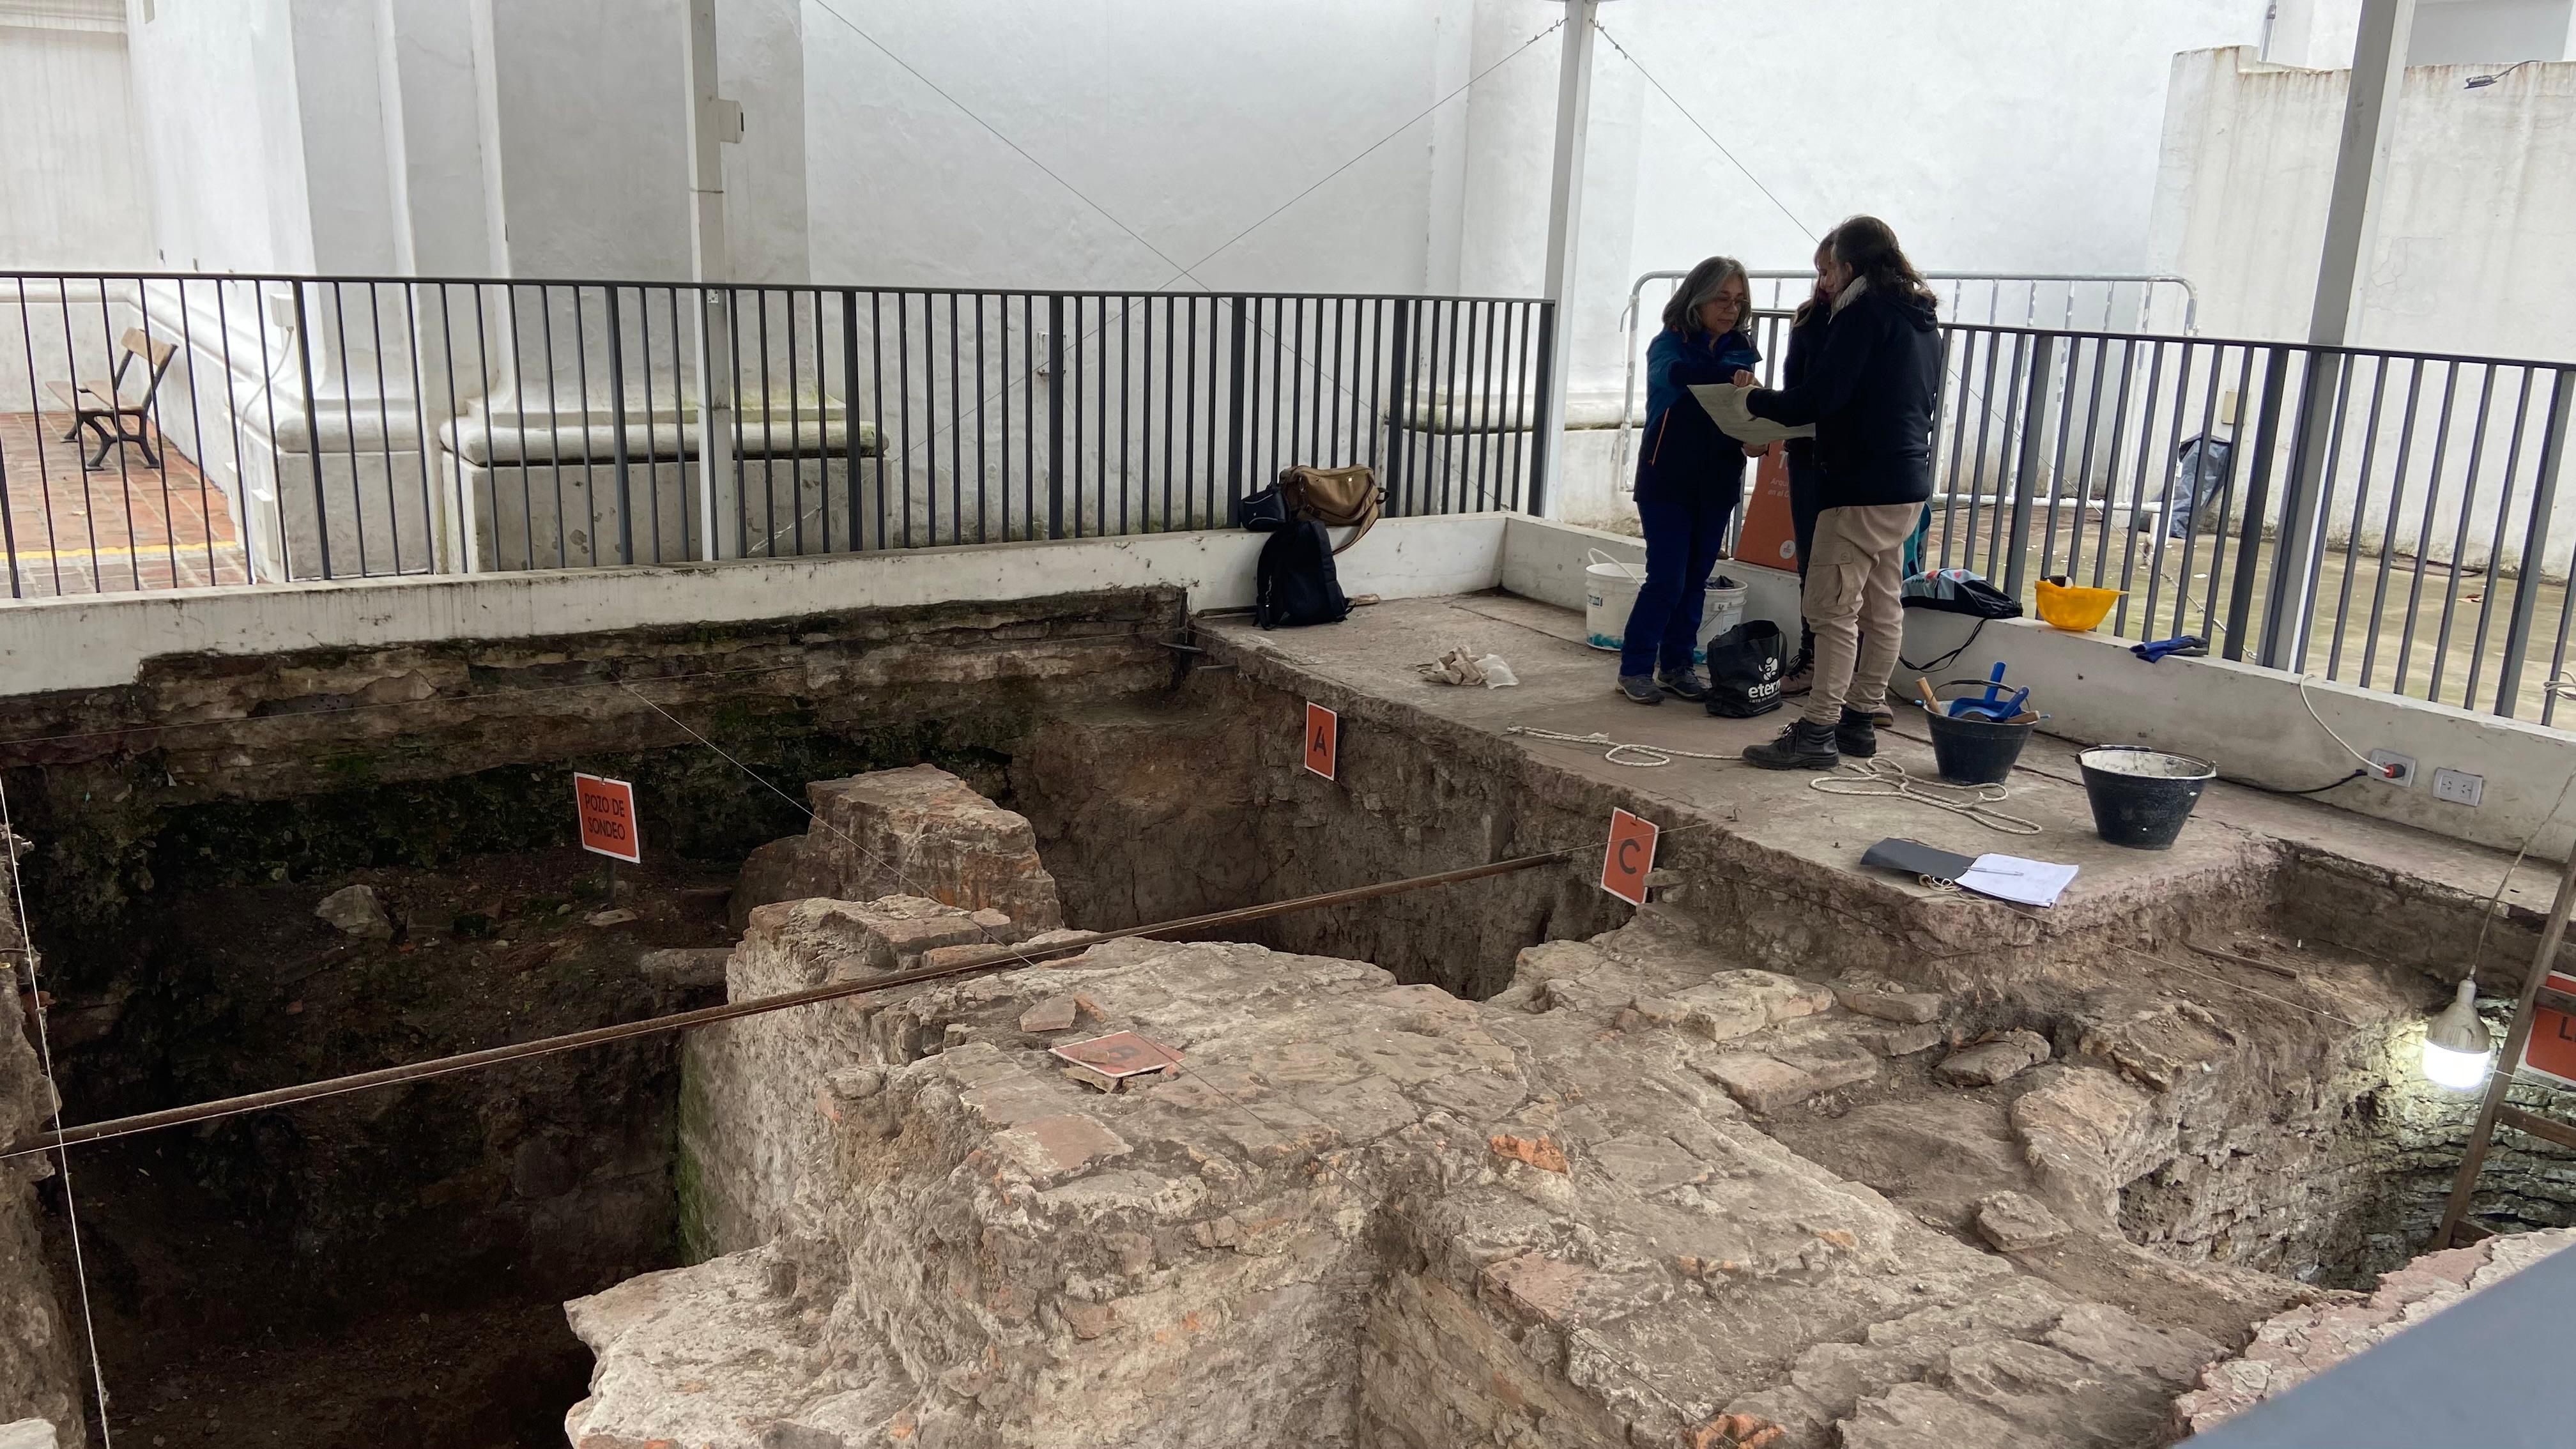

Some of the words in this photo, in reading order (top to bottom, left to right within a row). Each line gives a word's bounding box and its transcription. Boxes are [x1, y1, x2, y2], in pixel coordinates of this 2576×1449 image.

[1779, 450, 1789, 470] T
[1314, 726, 1327, 756] A
[584, 793, 610, 813] POZO
[612, 798, 625, 817] DE
[588, 816, 625, 840] SONDEO
[1618, 838, 1641, 875] C
[2559, 1016, 2576, 1043] L
